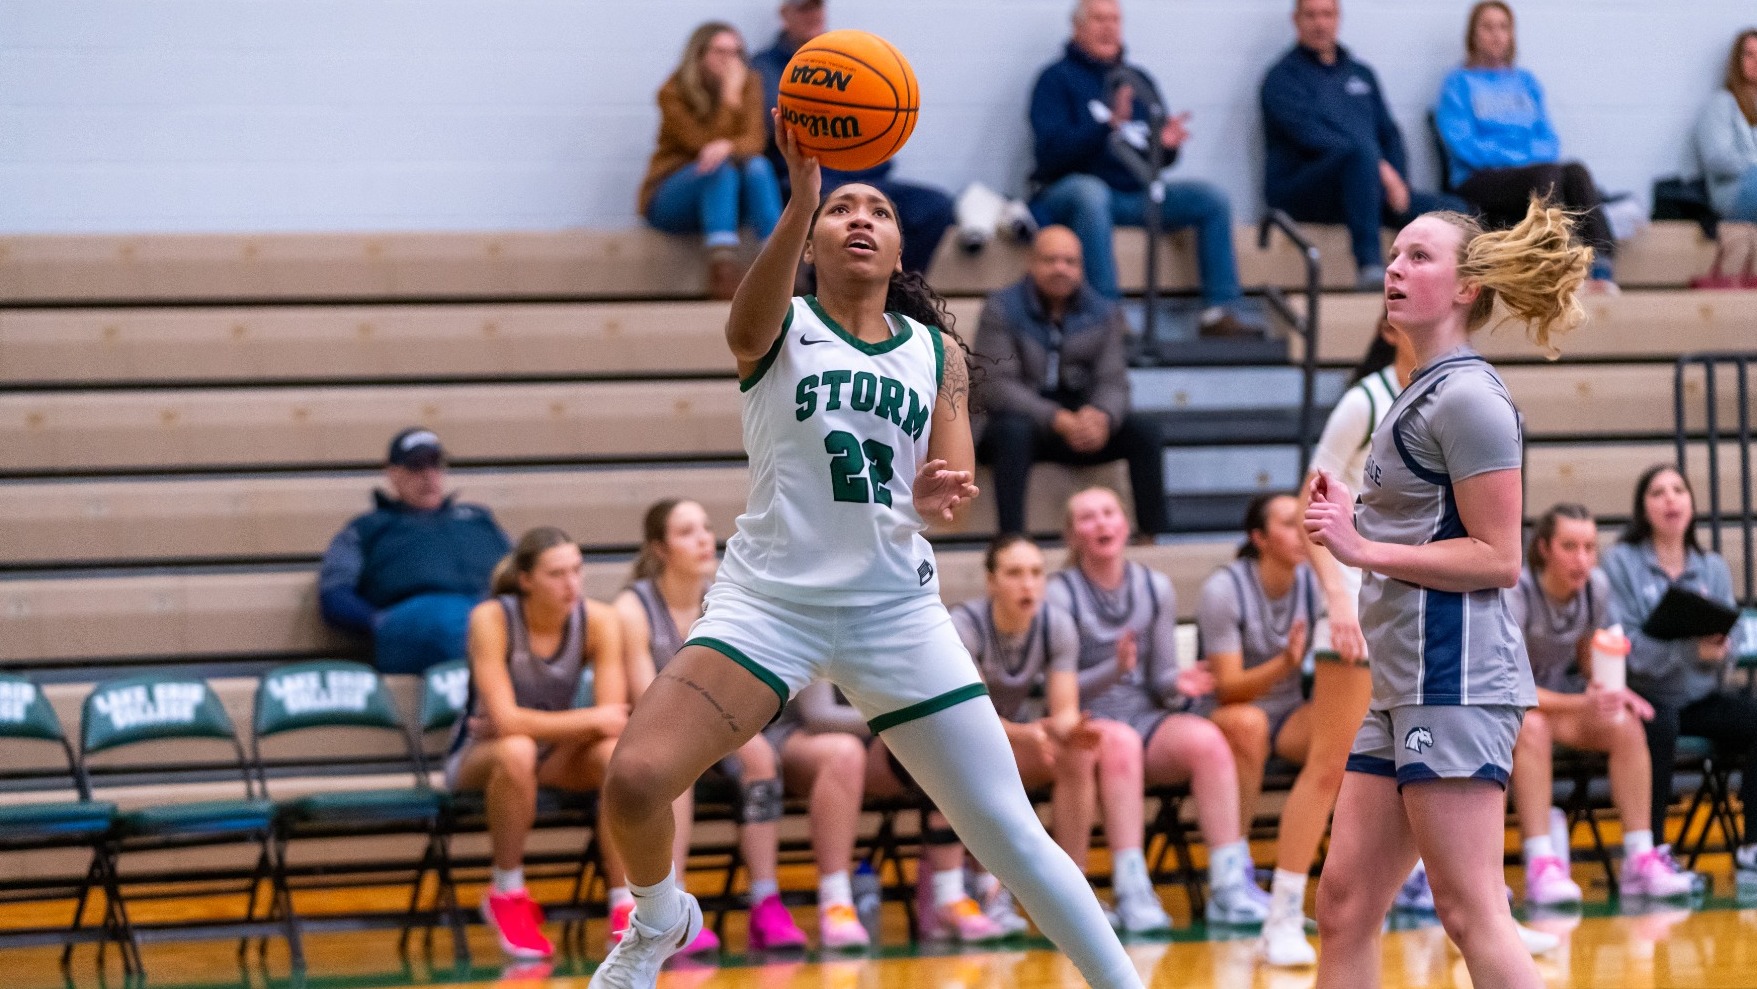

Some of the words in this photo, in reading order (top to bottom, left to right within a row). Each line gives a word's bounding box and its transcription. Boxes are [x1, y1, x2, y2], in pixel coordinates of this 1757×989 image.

[791, 65, 853, 92] NCAA
[781, 103, 862, 139] Wilson
[796, 369, 930, 443] STORM
[824, 430, 895, 510] 22
